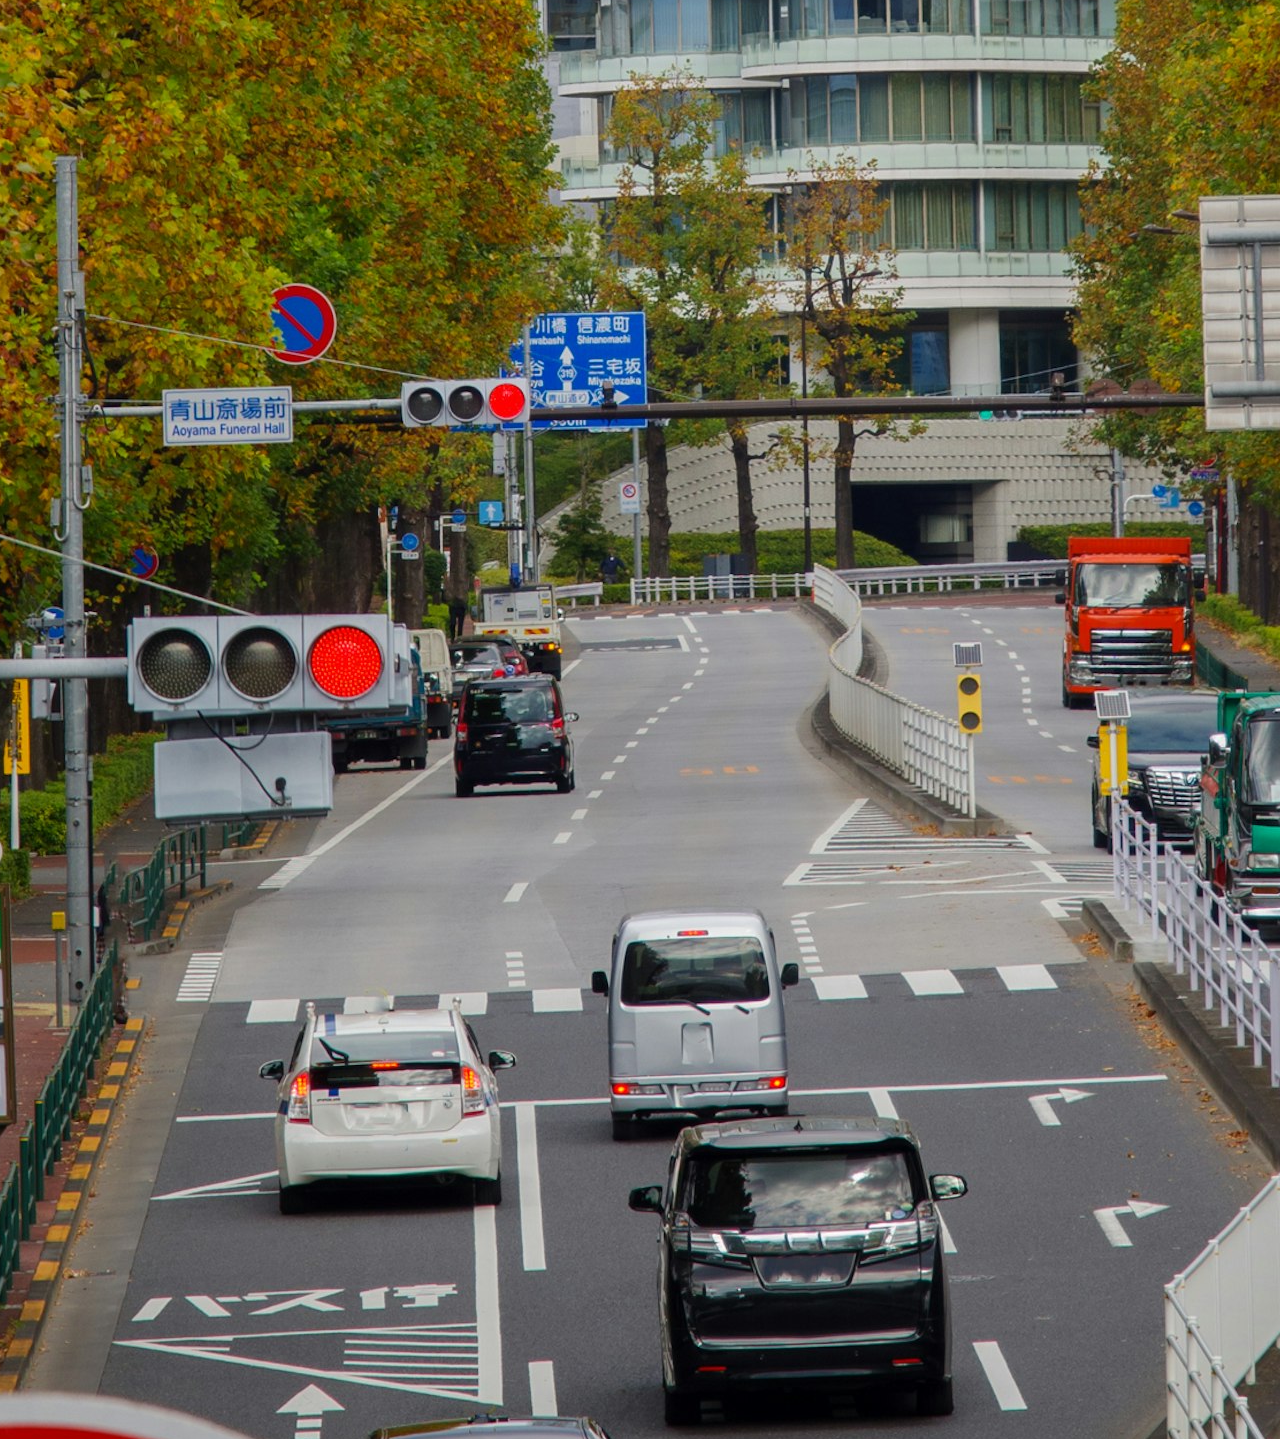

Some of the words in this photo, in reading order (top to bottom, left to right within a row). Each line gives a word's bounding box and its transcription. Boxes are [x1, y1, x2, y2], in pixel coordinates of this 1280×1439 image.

[577, 317, 629, 333] 信濃町
[577, 335, 630, 344] Shinanomachi
[588, 358, 641, 375] 三宅坂
[548, 393, 588, 403] 青山通り
[169, 396, 285, 421] 青山斎場前
[172, 425, 216, 437] Aoyama
[220, 423, 260, 435] Funeral
[264, 422, 285, 434] Hall
[131, 1284, 459, 1322] バス停
